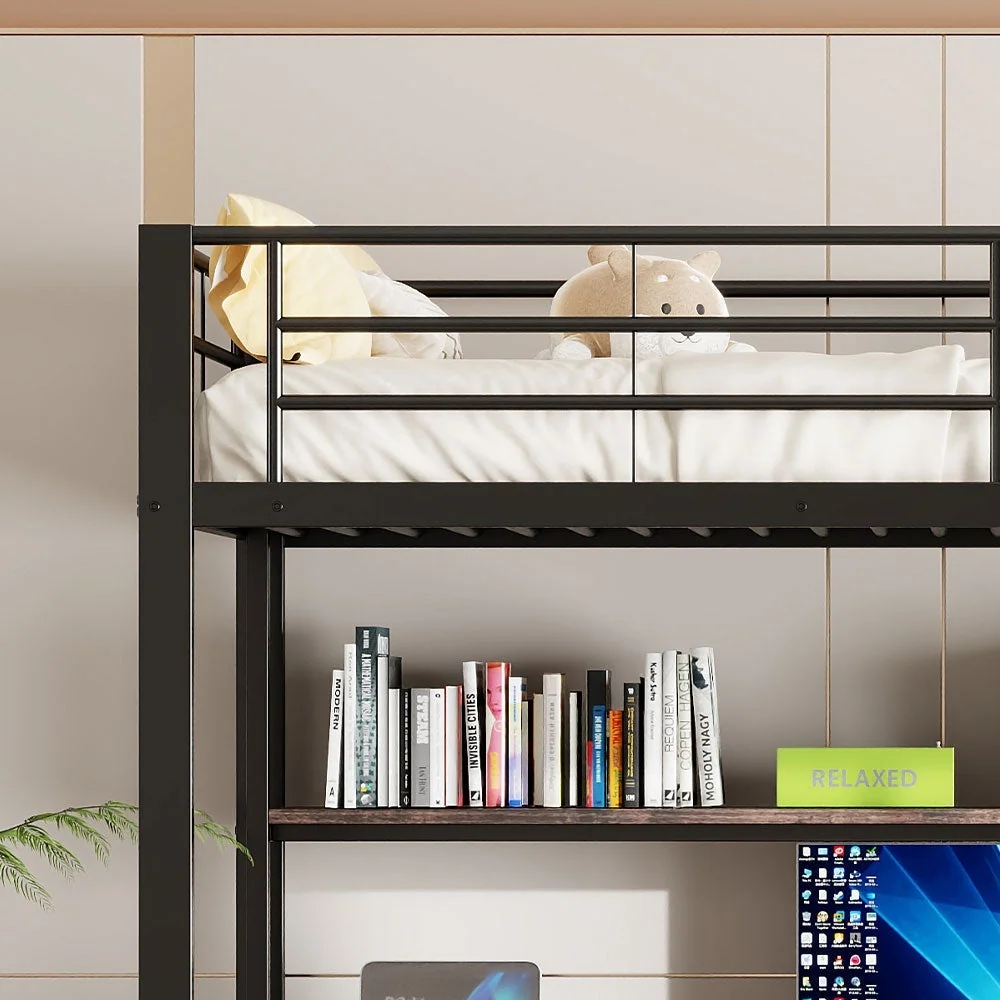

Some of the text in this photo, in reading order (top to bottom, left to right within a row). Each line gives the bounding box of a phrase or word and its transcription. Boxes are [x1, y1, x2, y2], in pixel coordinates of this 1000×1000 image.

[332, 678, 342, 730] MODERN
[466, 693, 479, 769] INVISIBLE CITIES
[664, 695, 675, 752] REQUIEM
[678, 661, 691, 770] COPEN HAGEN
[699, 713, 715, 801] MOHOLY NAGY
[811, 768, 918, 788] RELAXED
